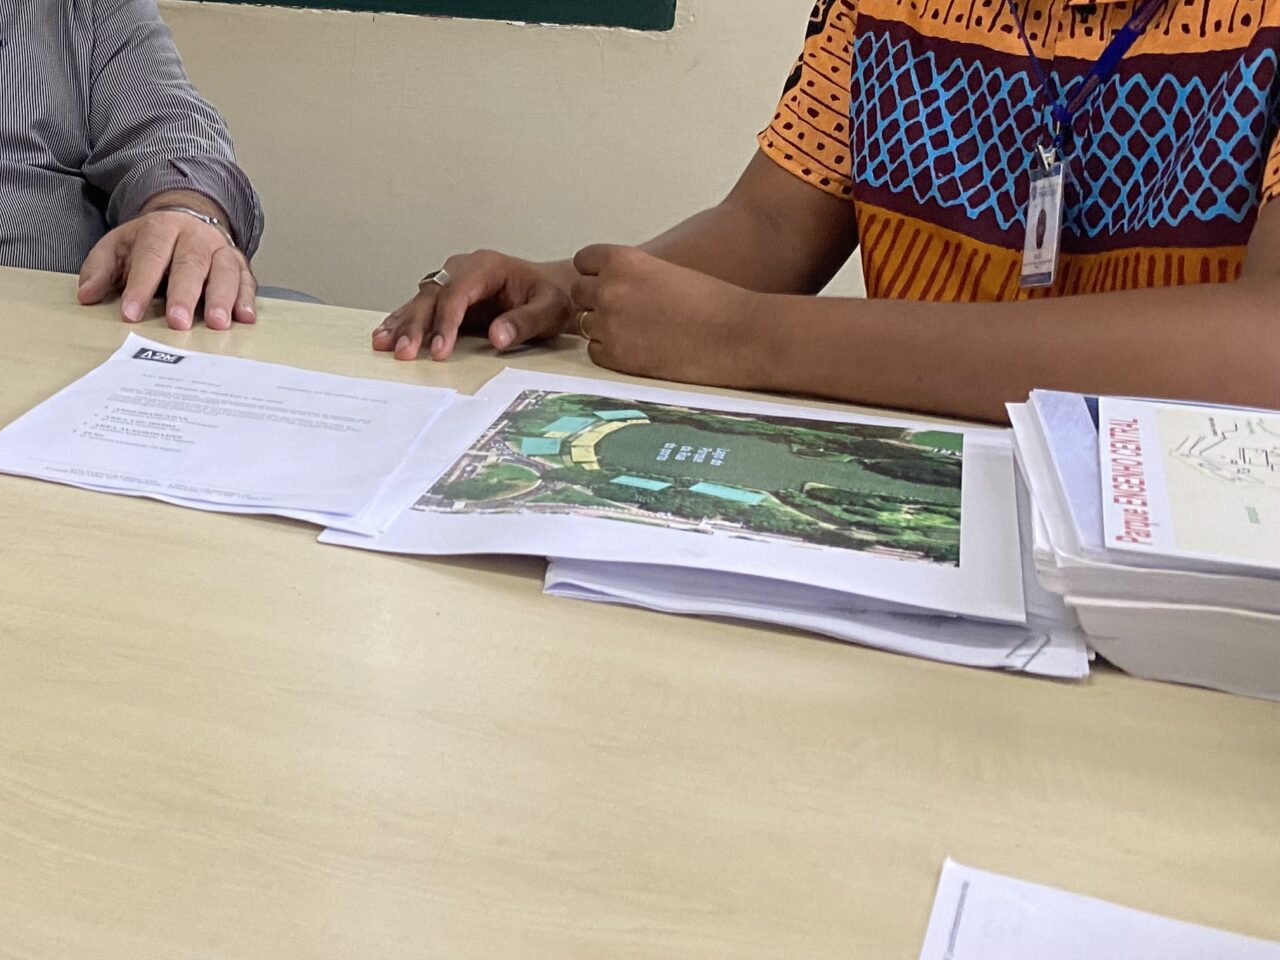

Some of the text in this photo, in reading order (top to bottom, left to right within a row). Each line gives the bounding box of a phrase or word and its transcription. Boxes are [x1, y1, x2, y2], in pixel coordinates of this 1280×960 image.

[1108, 418, 1159, 545] Parque ENGENHO CENTRAL
